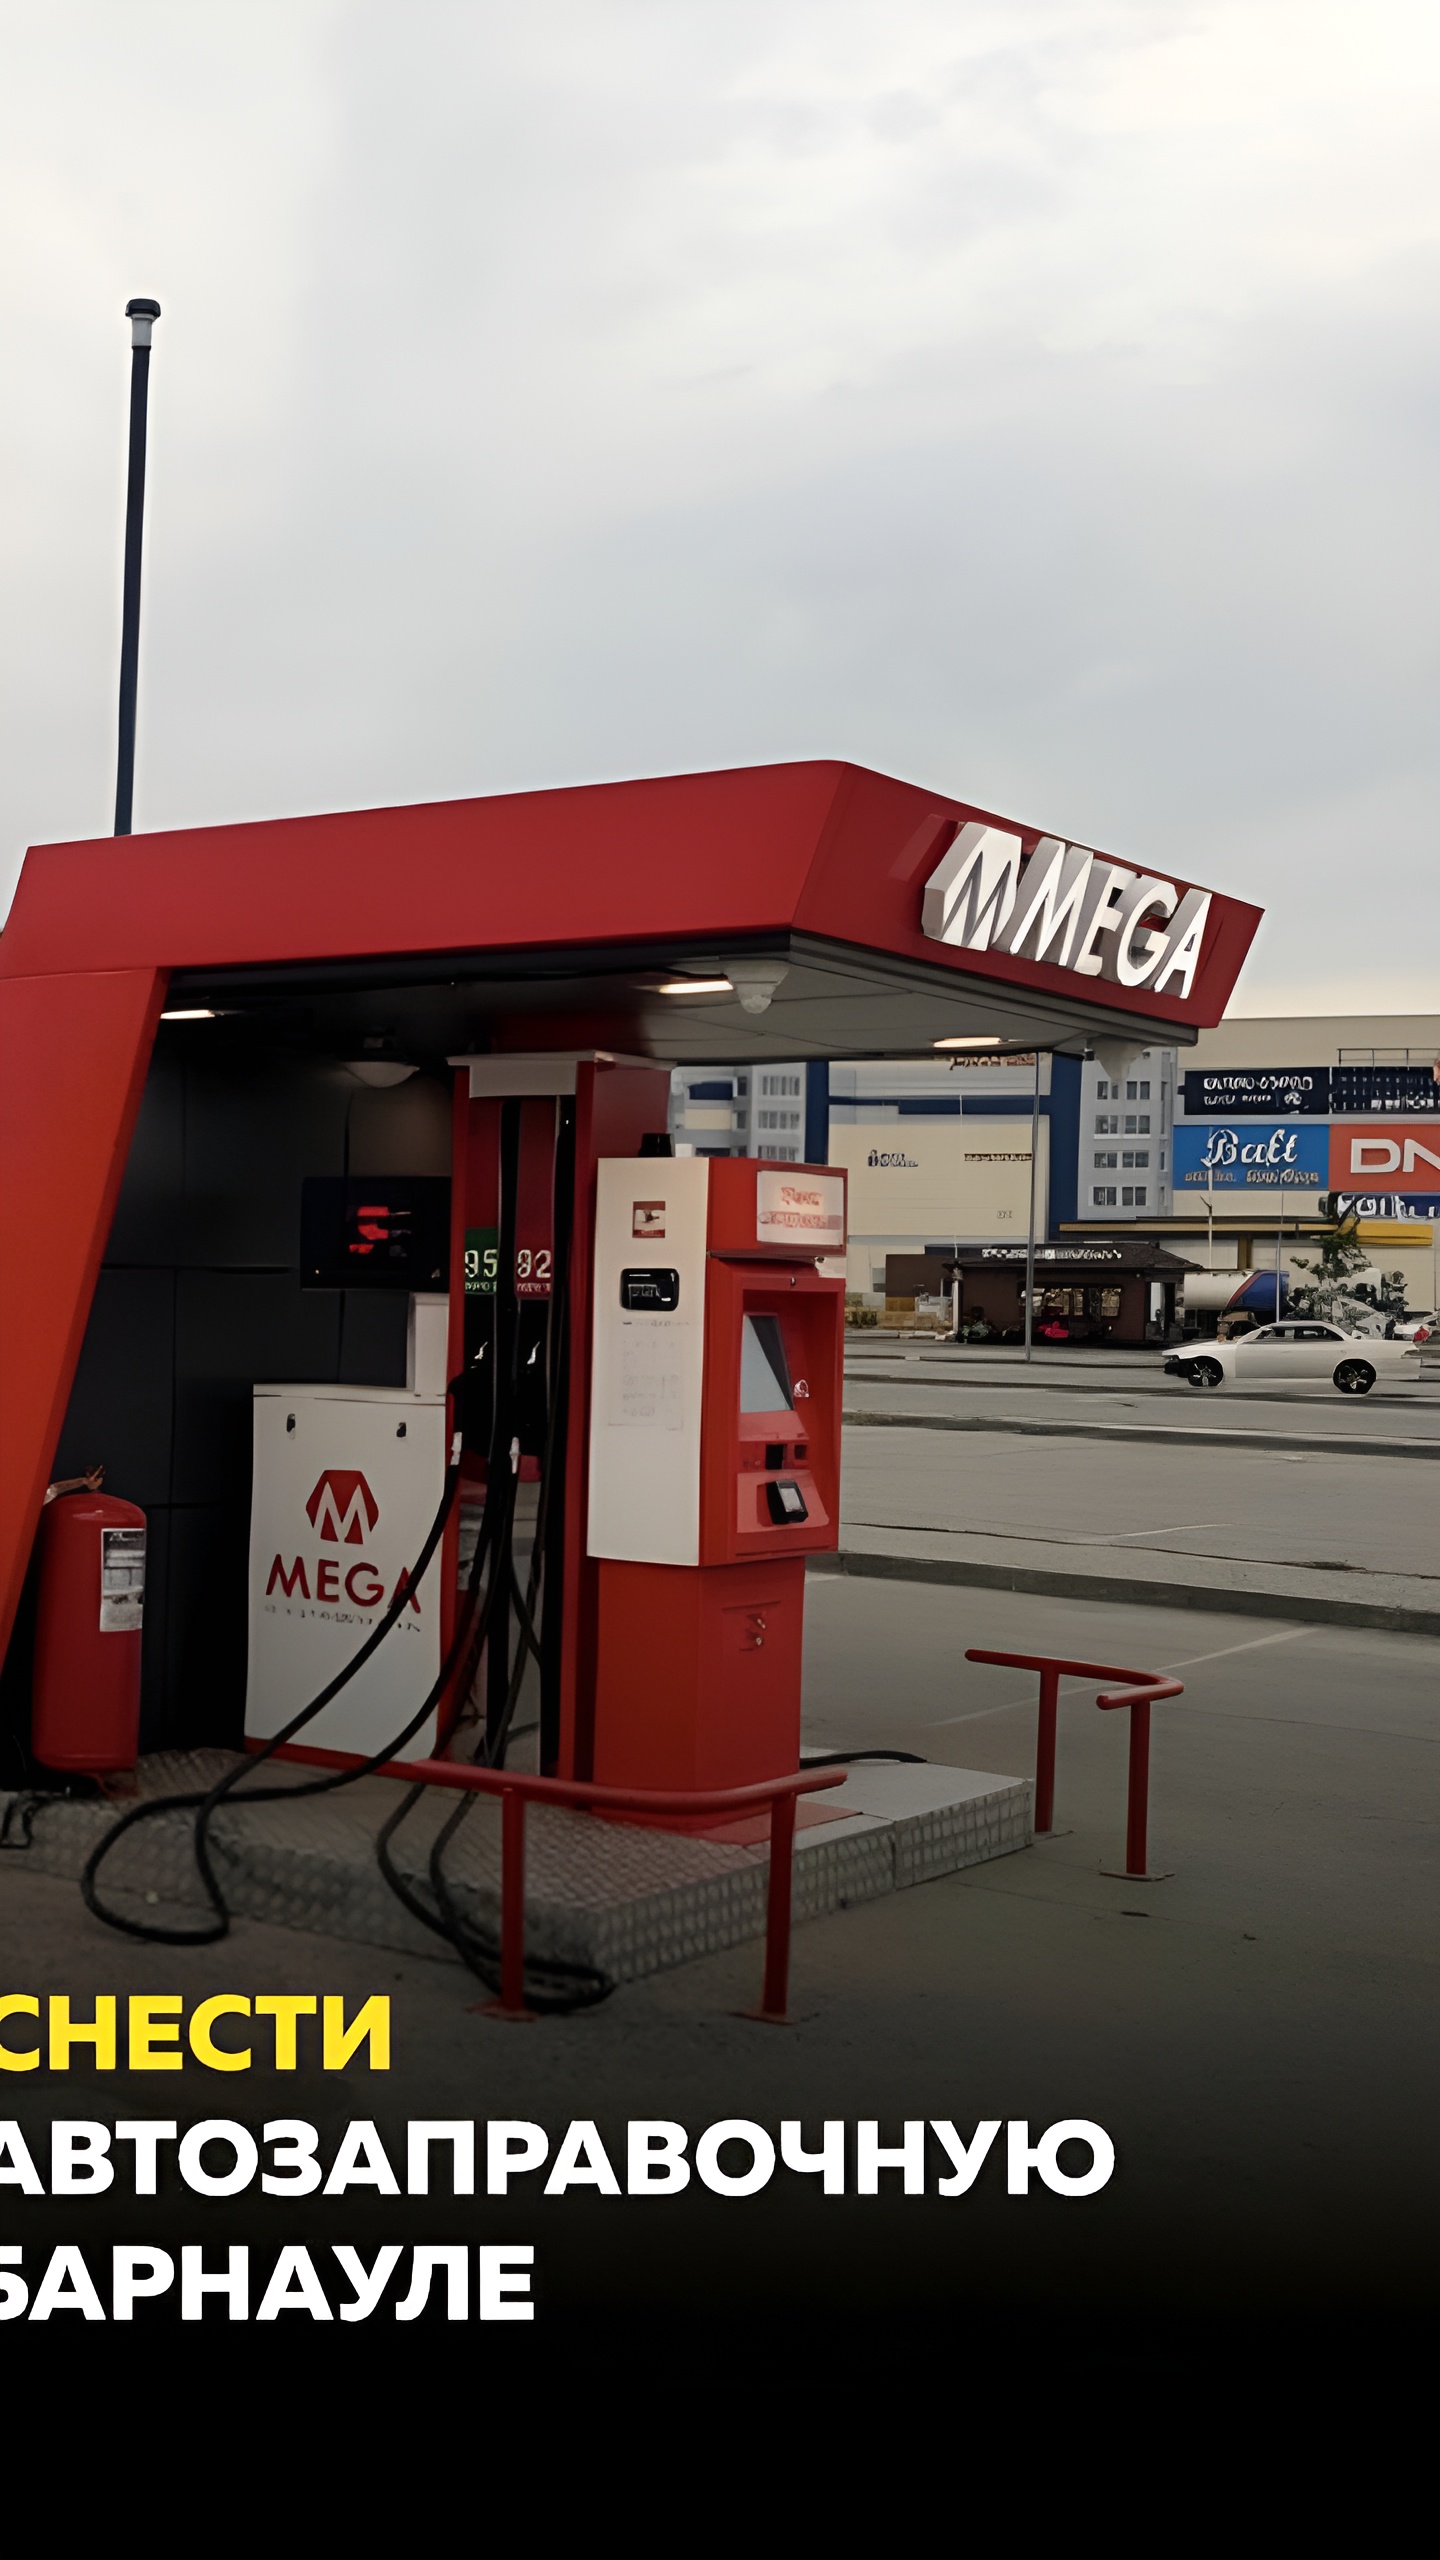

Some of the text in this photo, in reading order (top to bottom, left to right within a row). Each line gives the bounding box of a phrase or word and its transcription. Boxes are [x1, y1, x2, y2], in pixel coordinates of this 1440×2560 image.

[1009, 836, 1213, 999] MEGA
[465, 1248, 498, 1278] 95
[265, 1553, 421, 1614] MEGA
